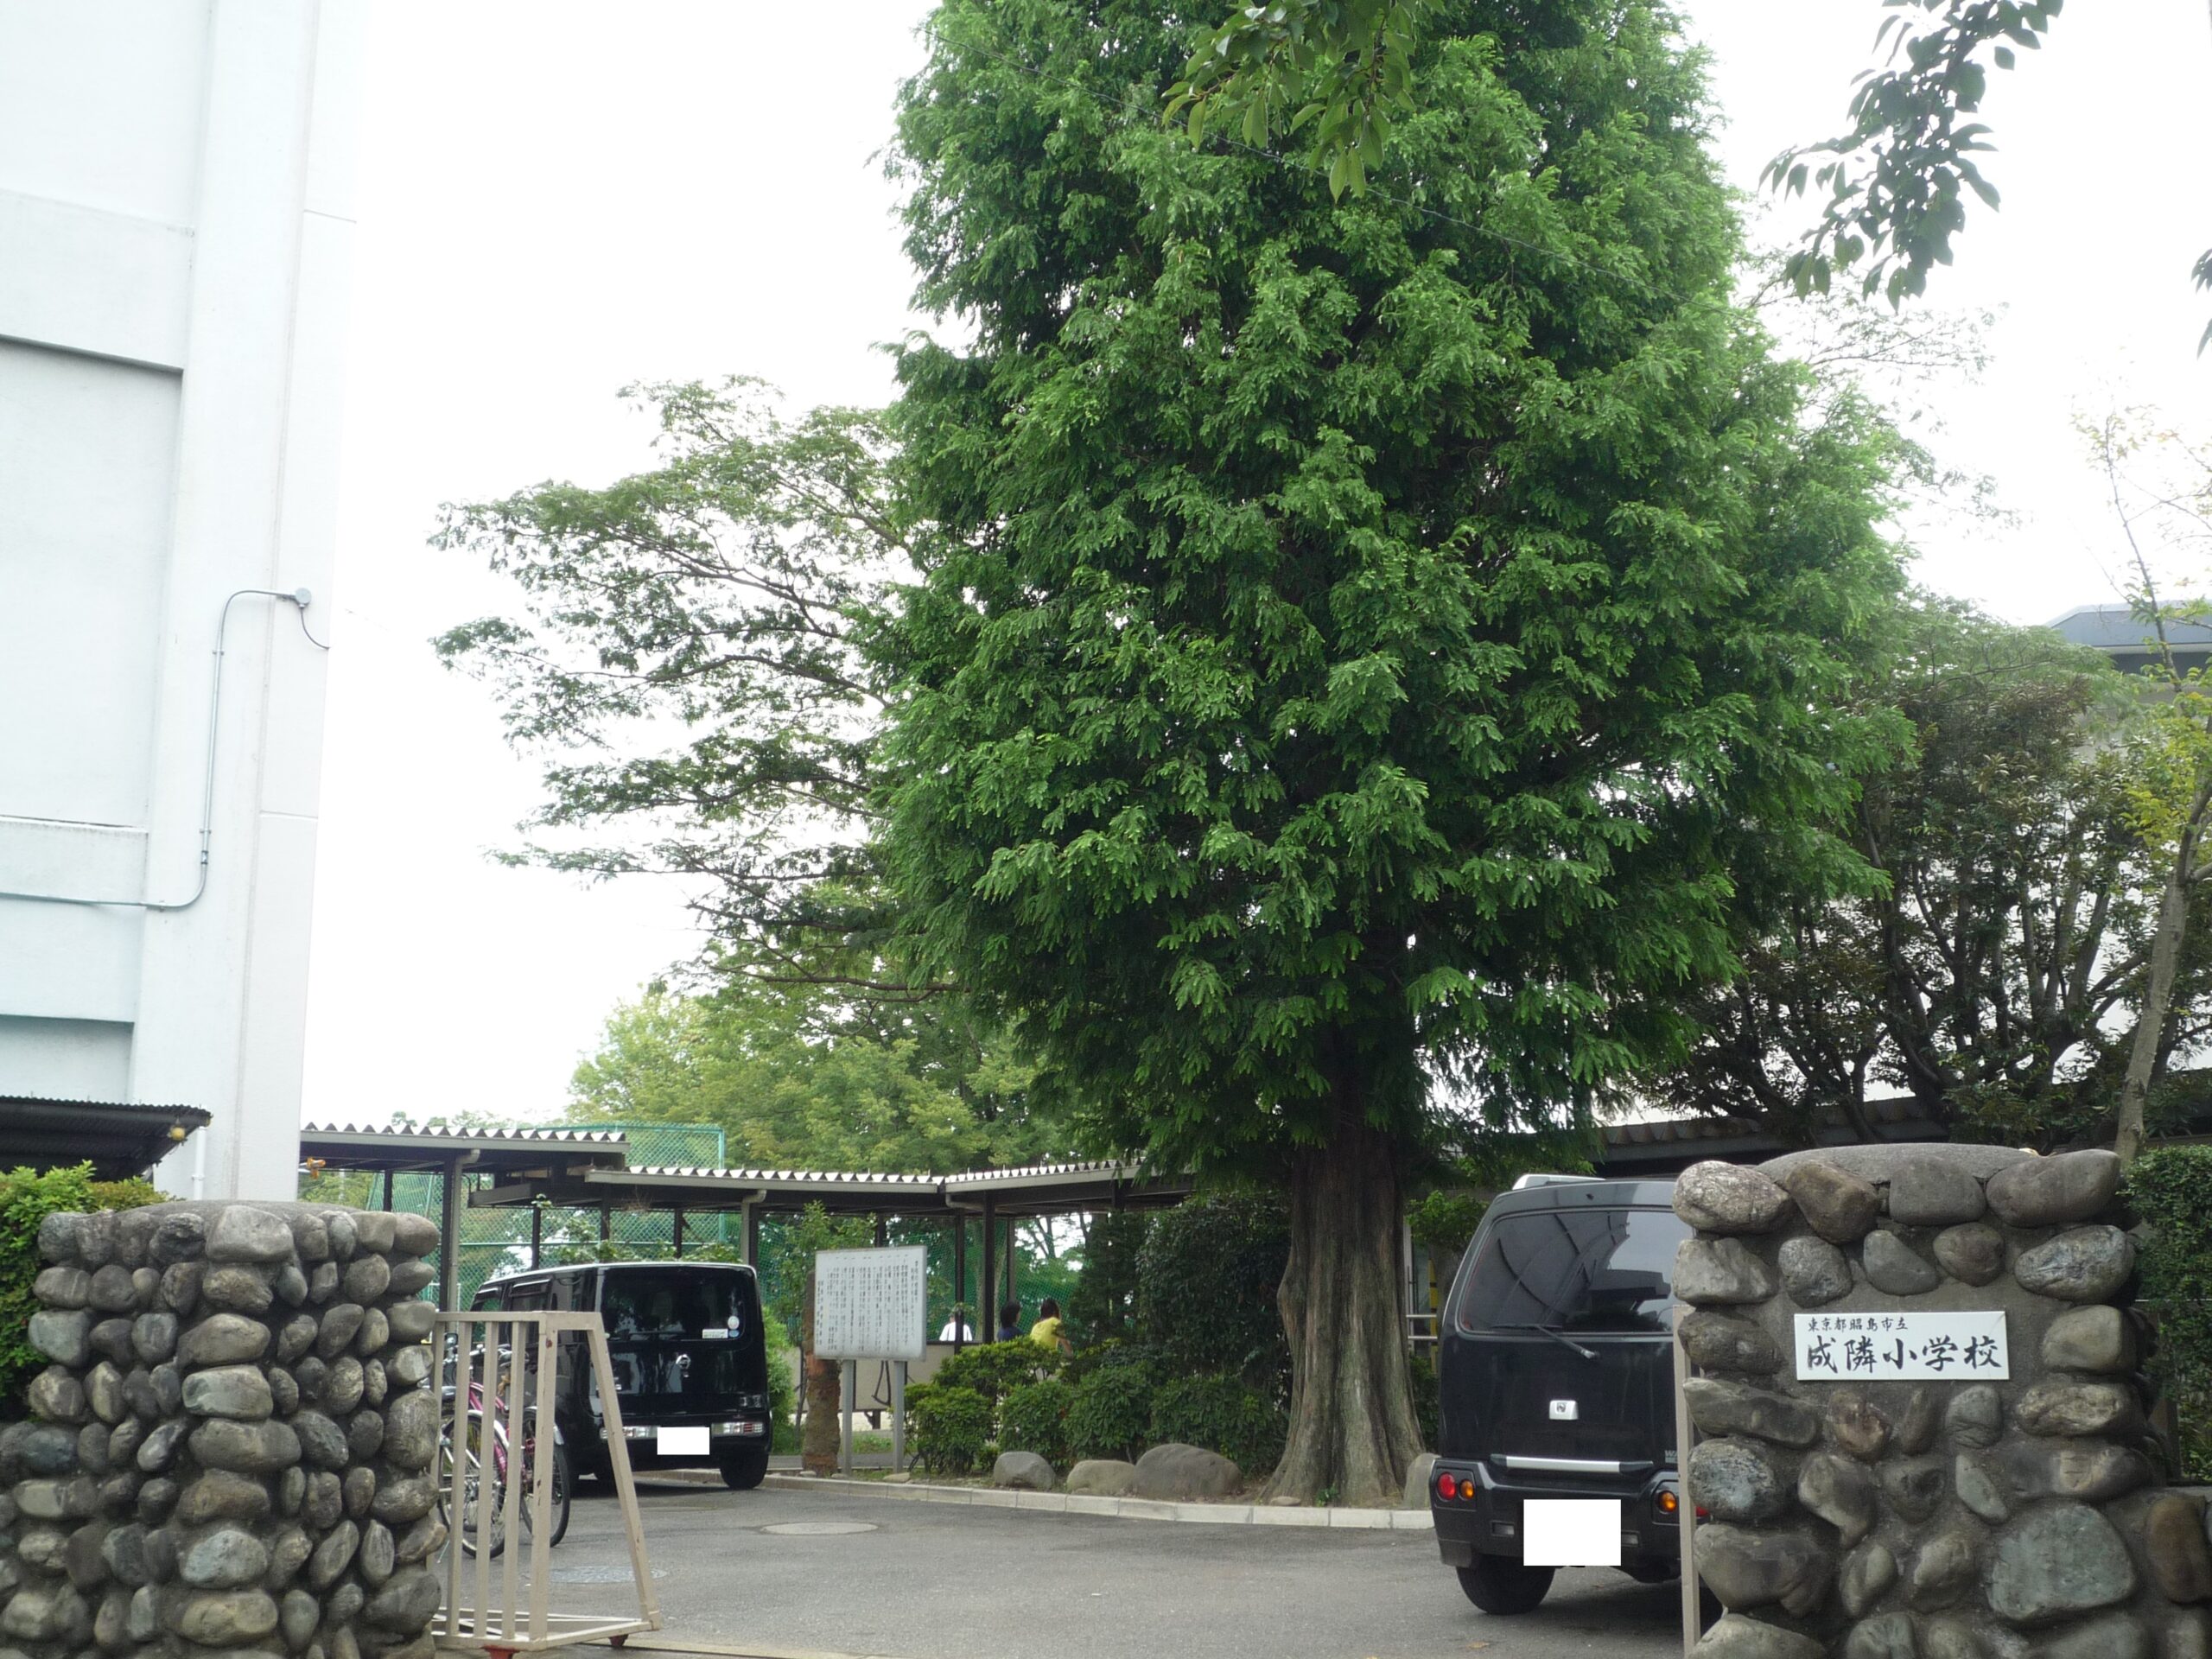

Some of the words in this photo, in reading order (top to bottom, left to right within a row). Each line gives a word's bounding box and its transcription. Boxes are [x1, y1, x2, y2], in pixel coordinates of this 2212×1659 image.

[1808, 1317, 1909, 1333] 東京都昭島市立
[1808, 1335, 2003, 1374] 成隣小学校
